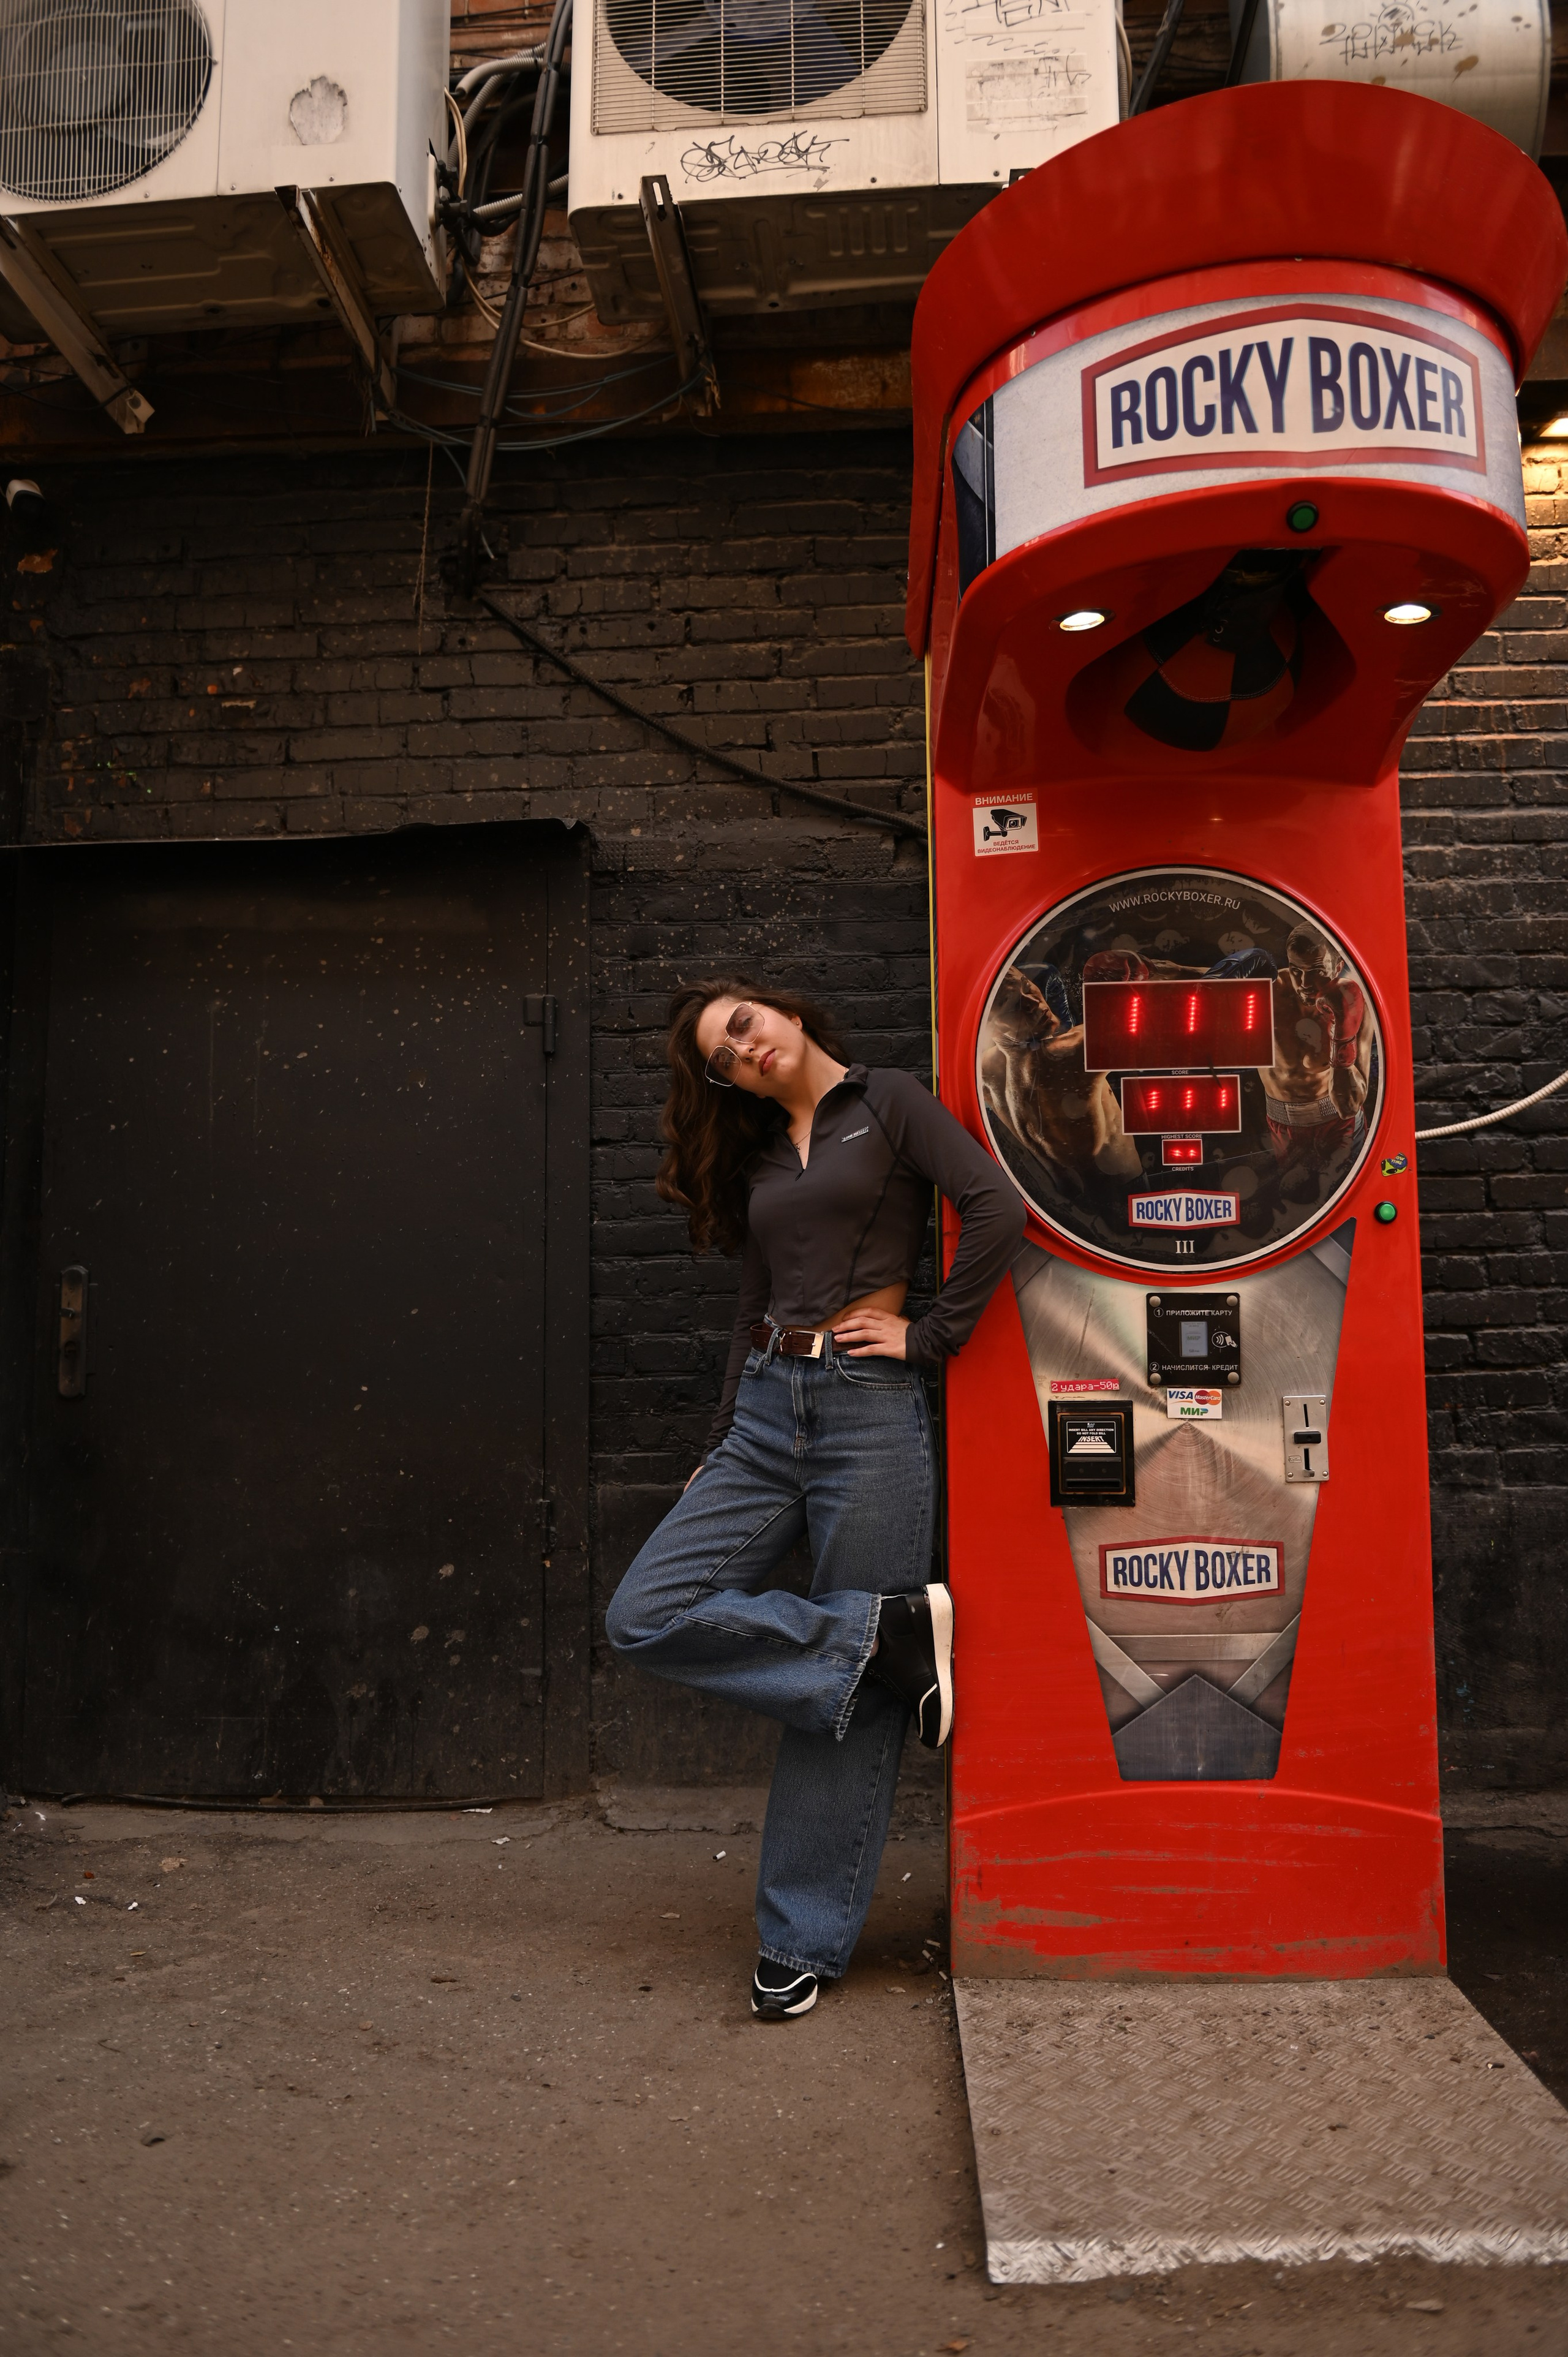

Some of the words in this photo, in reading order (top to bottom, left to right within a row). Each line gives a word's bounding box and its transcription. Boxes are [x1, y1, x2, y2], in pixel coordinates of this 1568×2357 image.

[1110, 337, 1294, 449] ROCKY
[1308, 336, 1467, 439] BOXER
[975, 793, 1033, 805] ВНИМАНИЕ
[978, 844, 1036, 854] ВИДЕОНАБЛЮДЕНИЕ
[1109, 891, 1241, 913] WWW.ROCKYBOXER.RU
[1136, 1197, 1182, 1221] ROCKY
[1185, 1197, 1232, 1221] BOXER
[1175, 1240, 1195, 1254] III
[1169, 1390, 1193, 1400] VISA
[1180, 1407, 1208, 1416] МИР
[1113, 1550, 1189, 1591] ROCKY
[1194, 1550, 1271, 1591] BOXER
